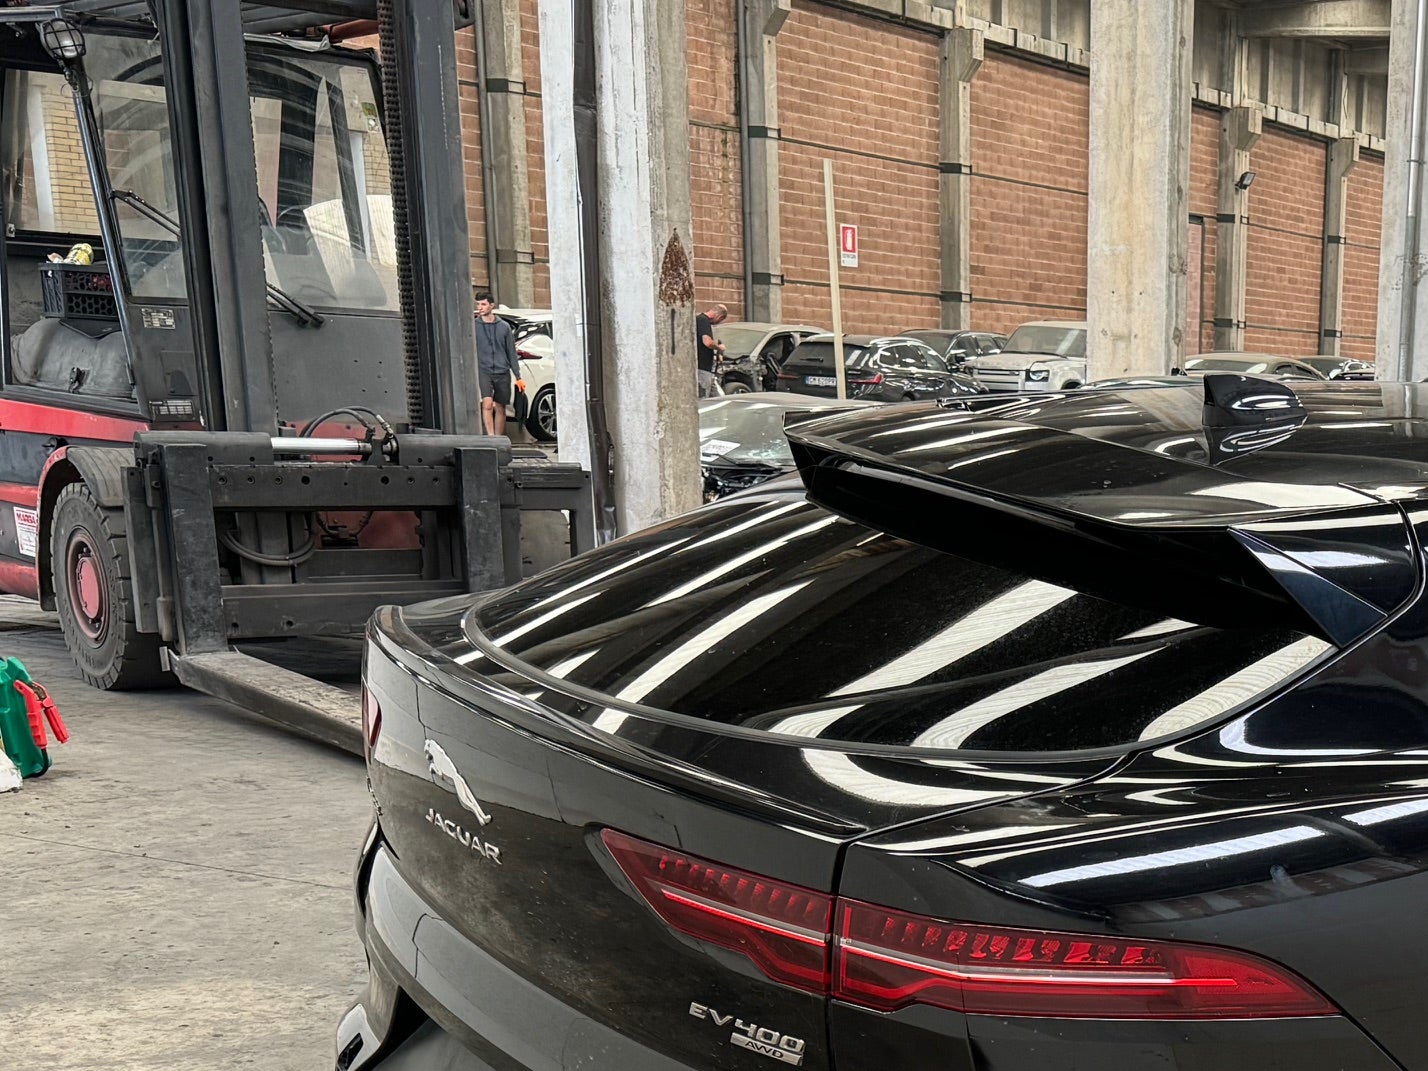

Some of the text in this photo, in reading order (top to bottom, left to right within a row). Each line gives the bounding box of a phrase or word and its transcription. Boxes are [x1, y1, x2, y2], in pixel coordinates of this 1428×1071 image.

[425, 808, 502, 865] JAGUAR
[689, 1002, 805, 1053] EV400
[745, 1041, 784, 1060] AWD
